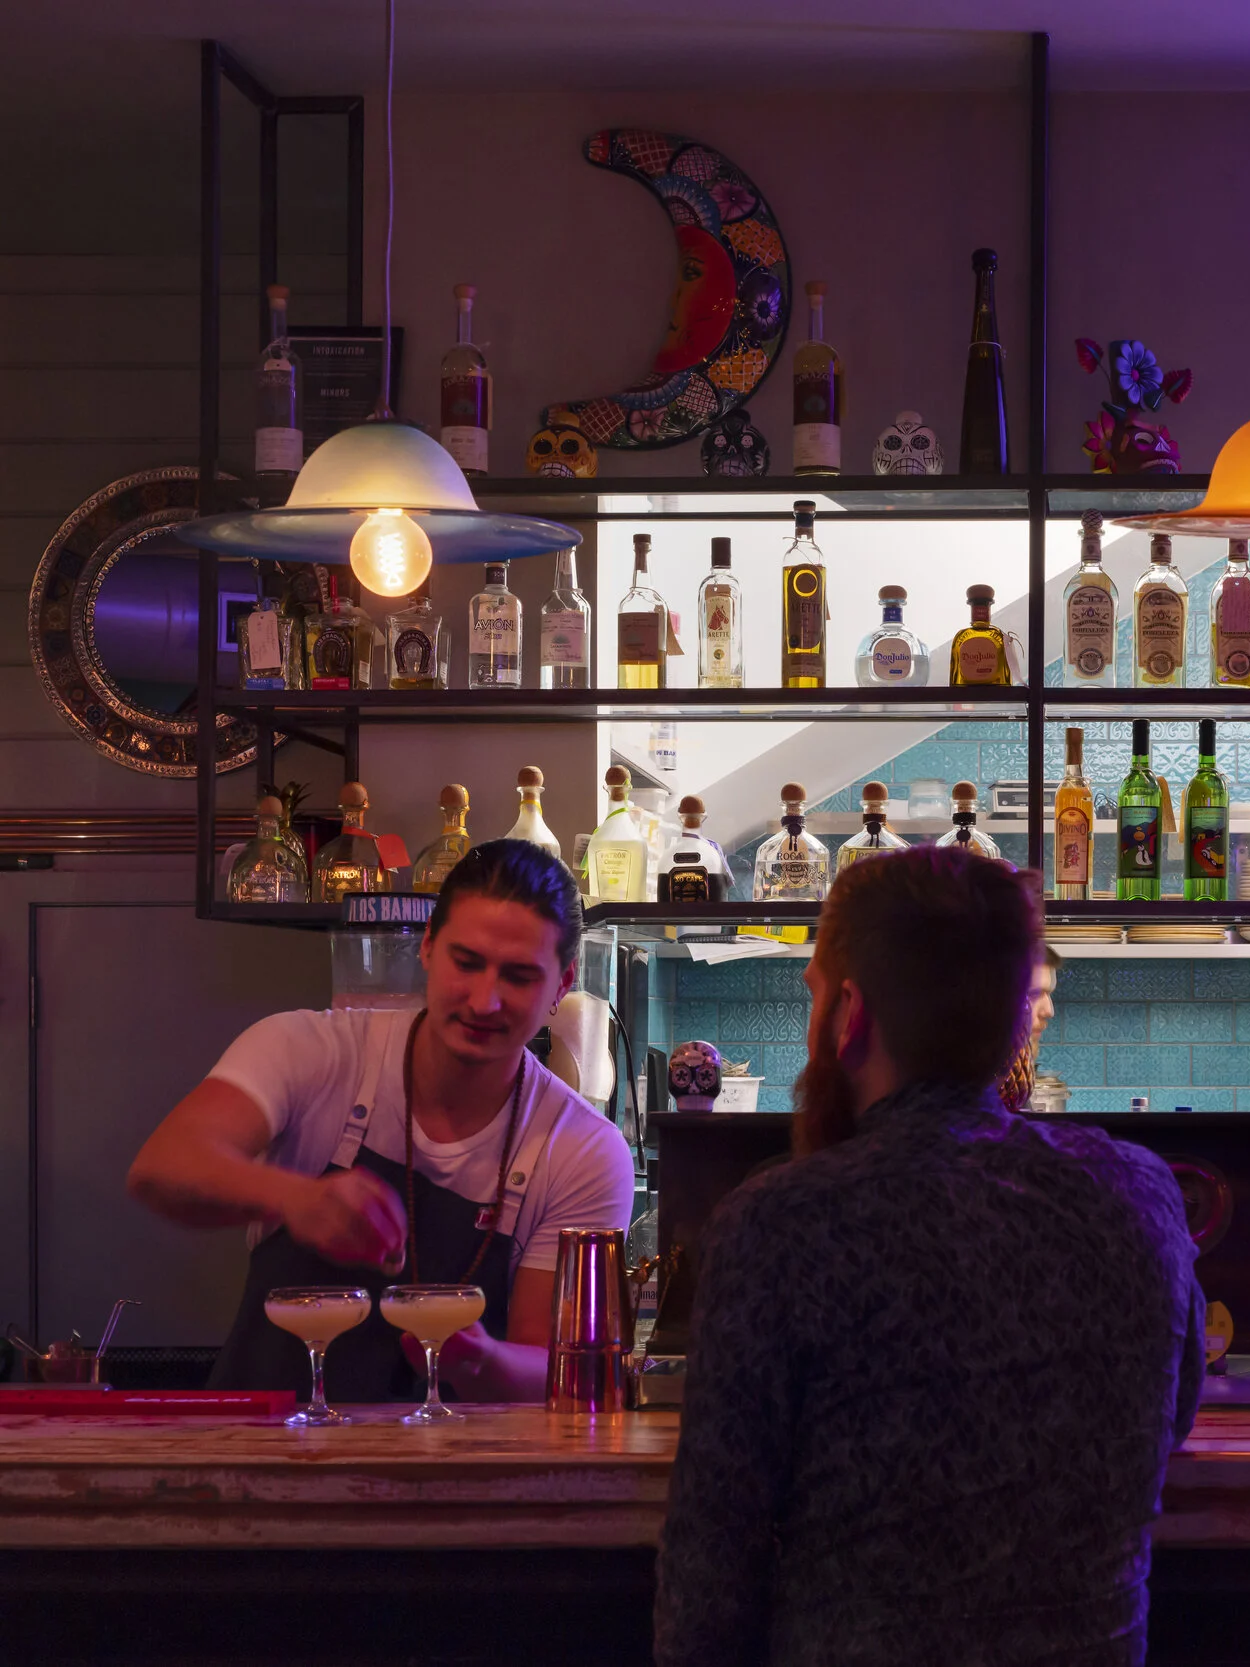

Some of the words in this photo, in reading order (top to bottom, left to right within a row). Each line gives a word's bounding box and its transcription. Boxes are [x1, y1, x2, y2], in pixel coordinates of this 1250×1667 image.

[312, 345, 365, 355] INTOXICATION
[320, 388, 350, 398] MINORS
[1058, 822, 1087, 836] DIVINO
[328, 868, 361, 879] PATRÓN
[353, 898, 376, 922] LOS
